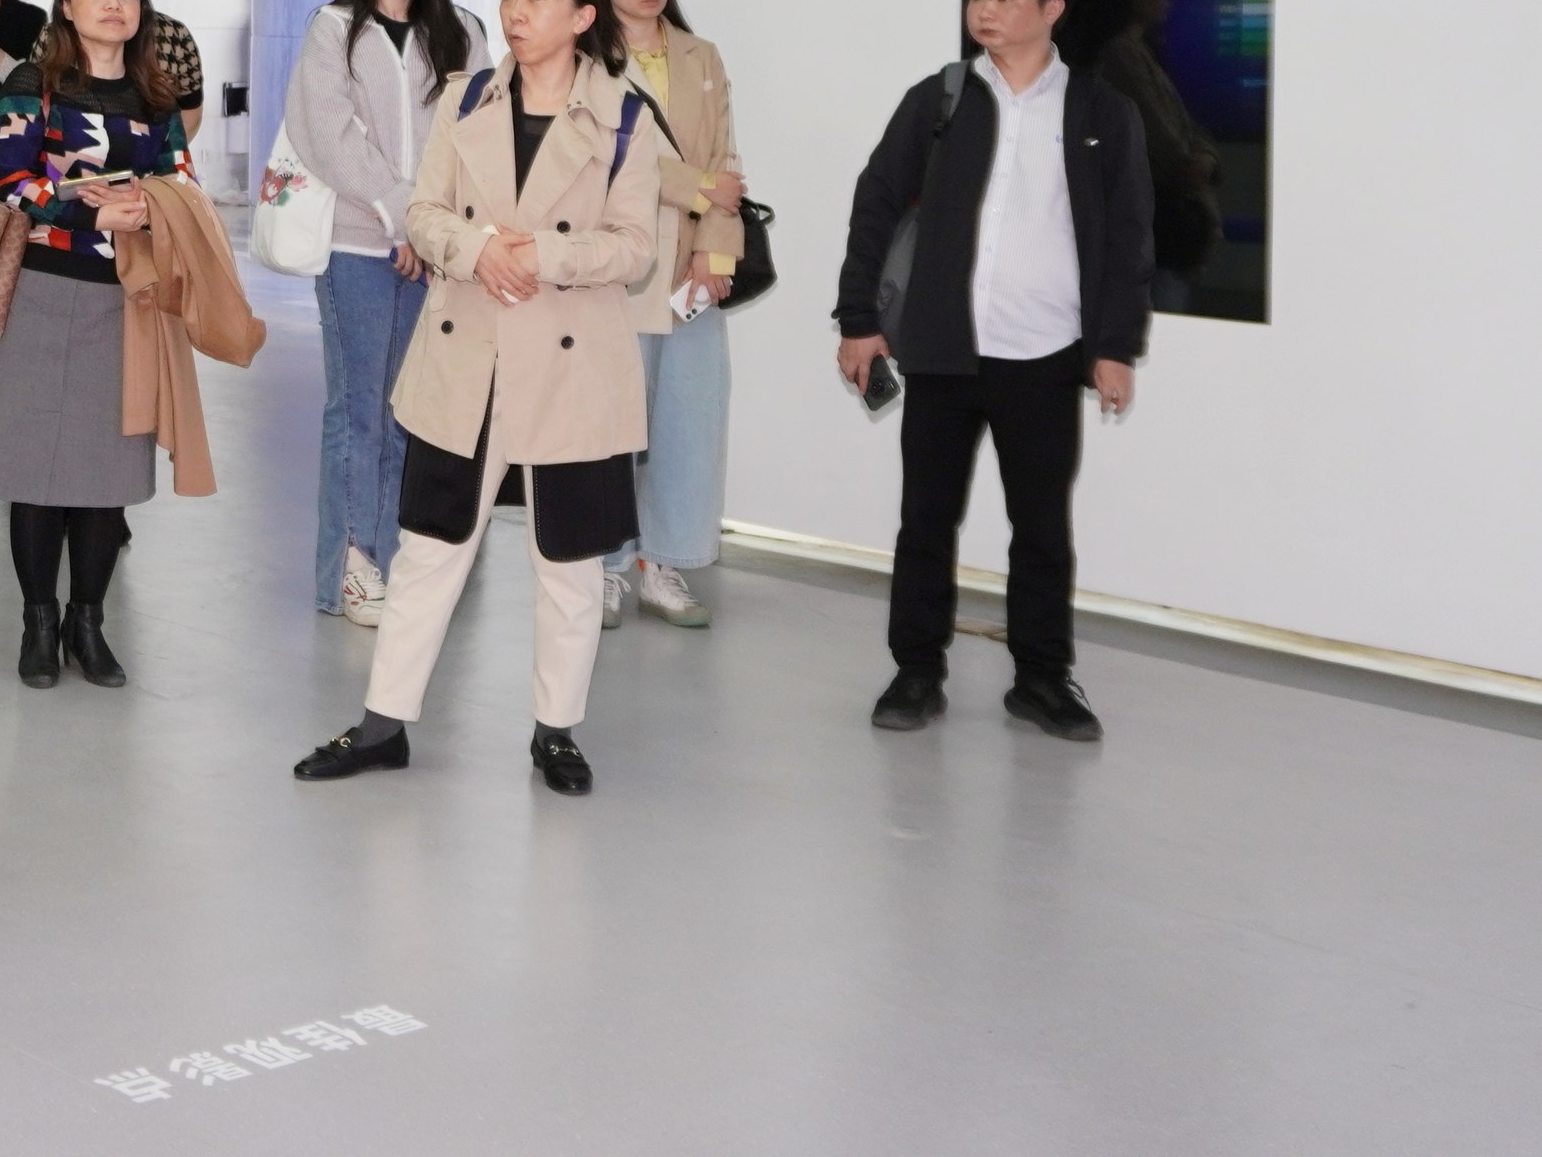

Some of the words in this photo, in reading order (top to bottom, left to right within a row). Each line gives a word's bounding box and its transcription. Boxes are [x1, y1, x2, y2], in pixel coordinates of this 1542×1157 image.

[93, 1004, 429, 1104] 最佳观影点
